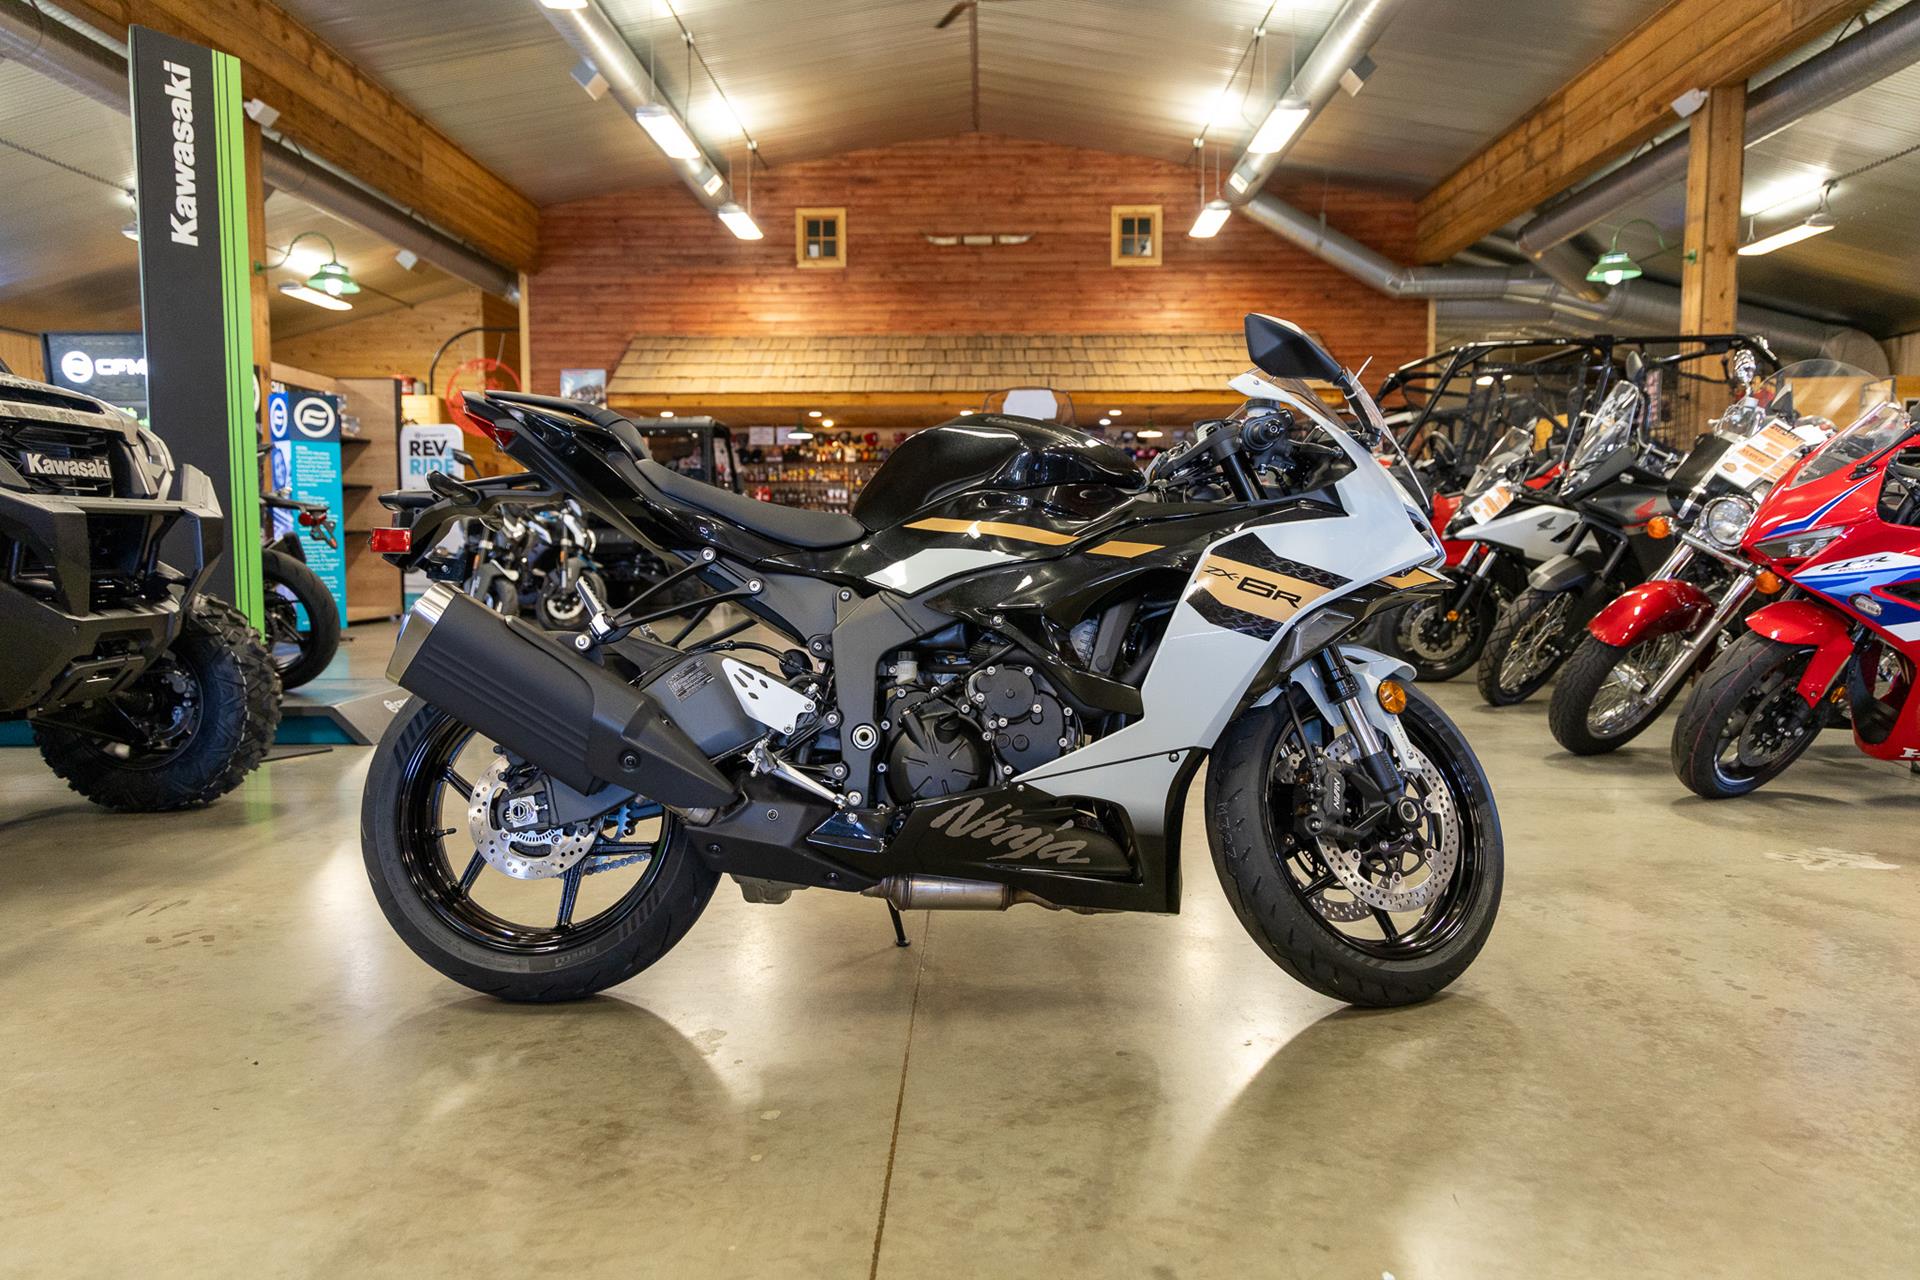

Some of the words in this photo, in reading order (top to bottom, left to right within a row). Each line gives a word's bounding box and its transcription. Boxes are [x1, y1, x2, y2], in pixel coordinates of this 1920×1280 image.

[163, 60, 199, 246] Kawasaki
[409, 440, 447, 456] REV
[27, 453, 112, 478] Kawasaki
[410, 459, 454, 475] RIDE
[1203, 565, 1302, 609] ZX-6R
[930, 797, 1090, 864] Ninja
